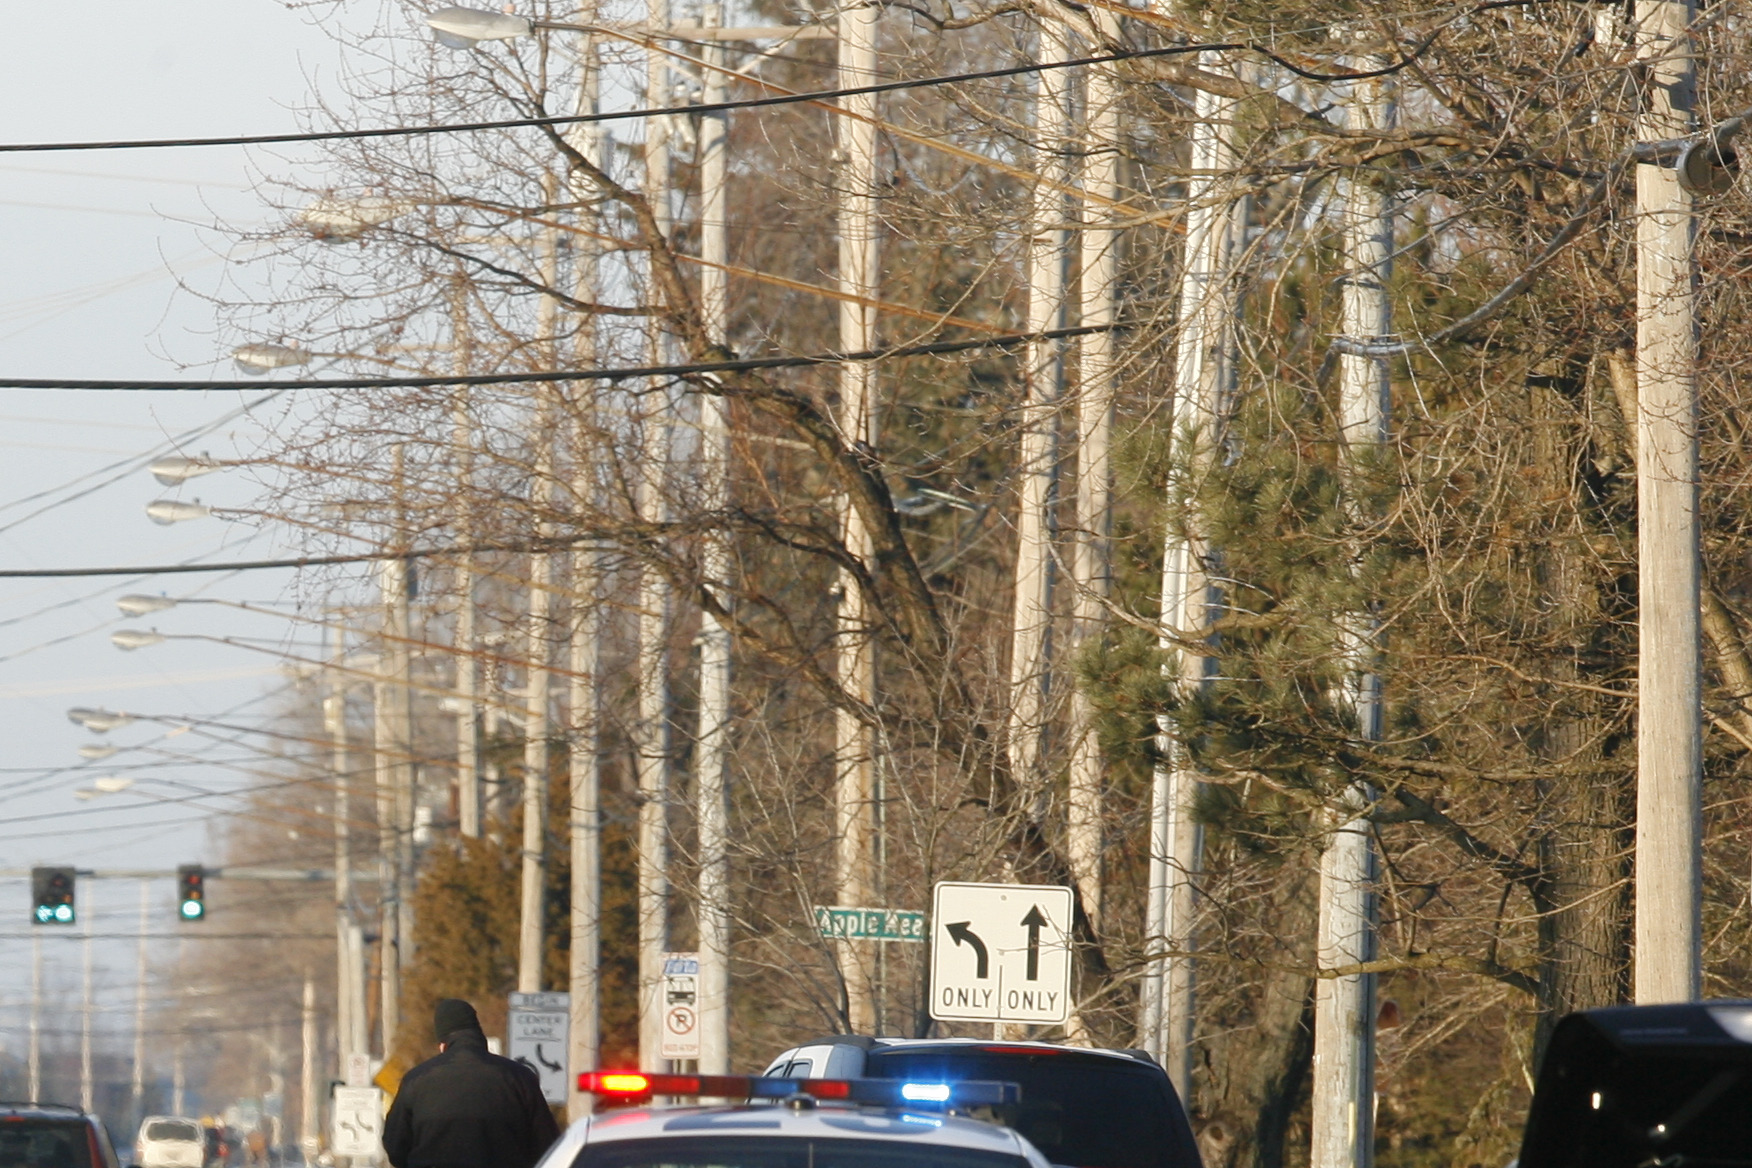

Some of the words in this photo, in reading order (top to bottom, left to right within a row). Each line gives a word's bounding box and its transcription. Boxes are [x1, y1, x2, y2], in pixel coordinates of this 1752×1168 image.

[819, 911, 879, 939] Apple
[942, 986, 993, 1009] ONLY
[1007, 989, 1059, 1012] ONLY
[516, 1014, 562, 1025] CENTER
[523, 1026, 554, 1036] LANE
